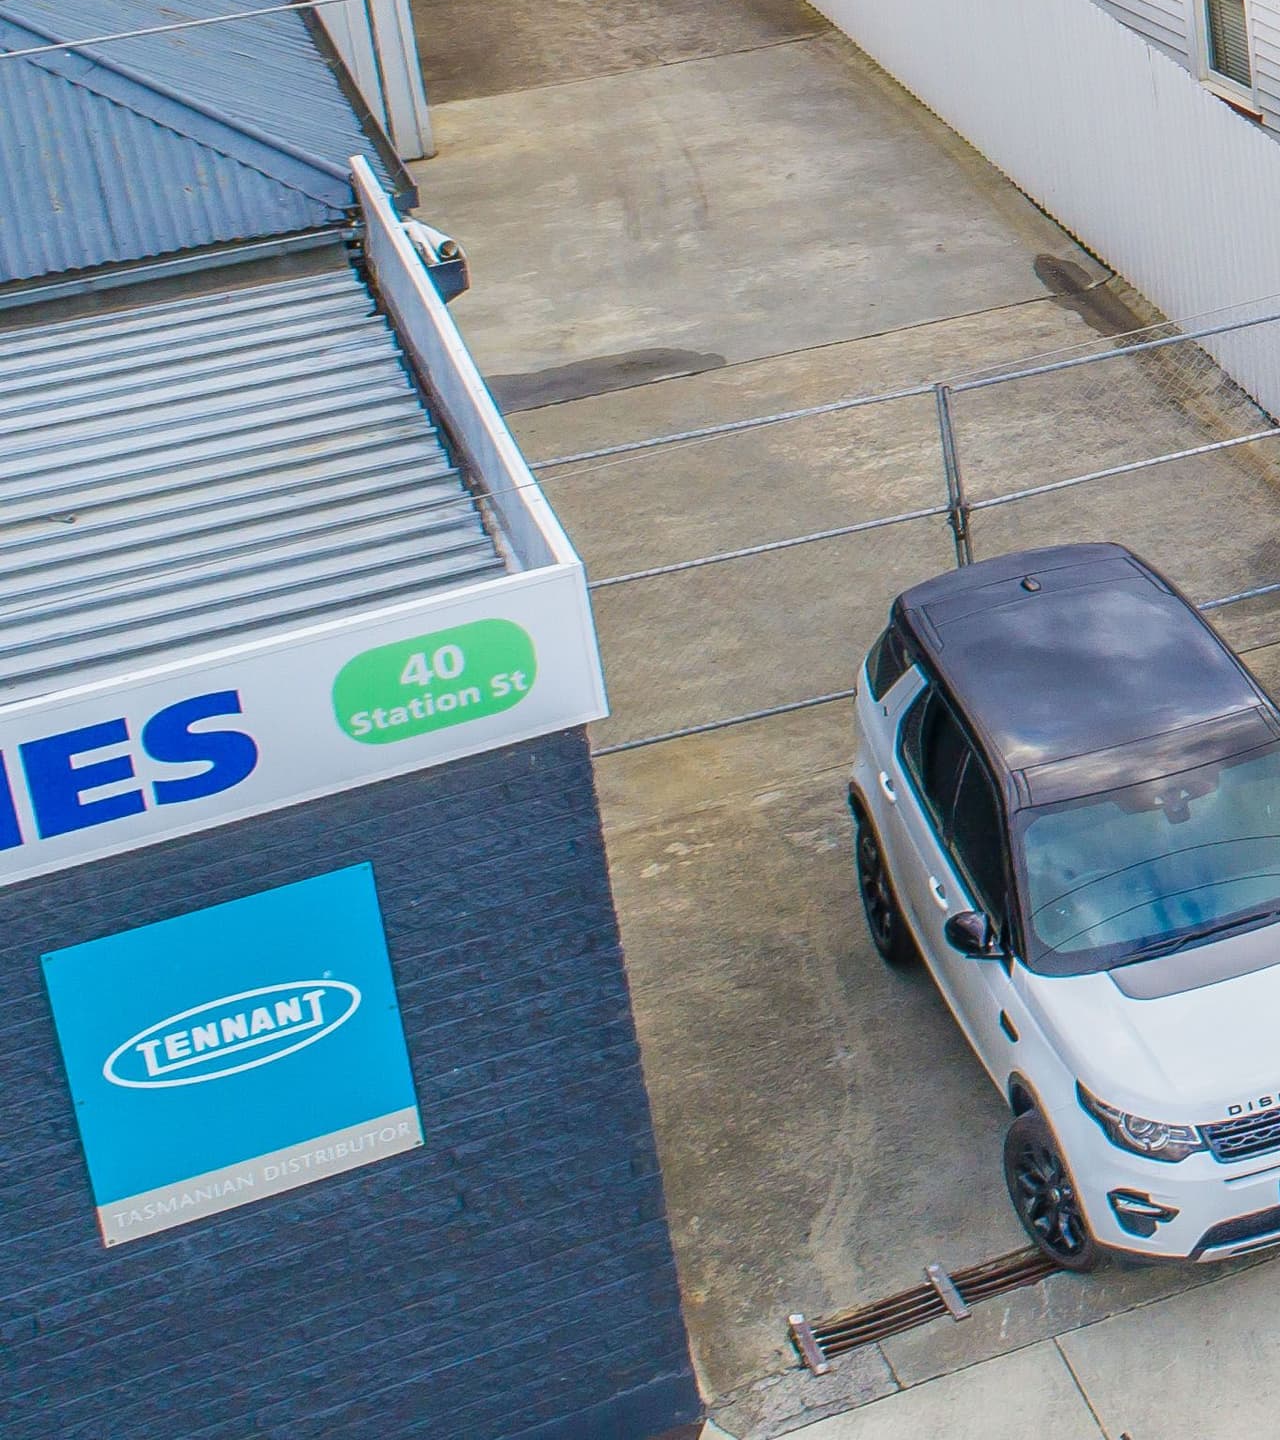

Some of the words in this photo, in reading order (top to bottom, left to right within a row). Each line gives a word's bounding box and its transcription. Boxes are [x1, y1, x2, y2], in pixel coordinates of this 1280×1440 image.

[350, 685, 481, 737] Station
[490, 669, 529, 694] St
[400, 643, 465, 687] 40
[0, 689, 259, 851] ES
[135, 989, 326, 1077] TENNANT
[113, 1173, 255, 1228] TASMANIAN
[263, 1122, 410, 1182] DISTRIBUTOR
